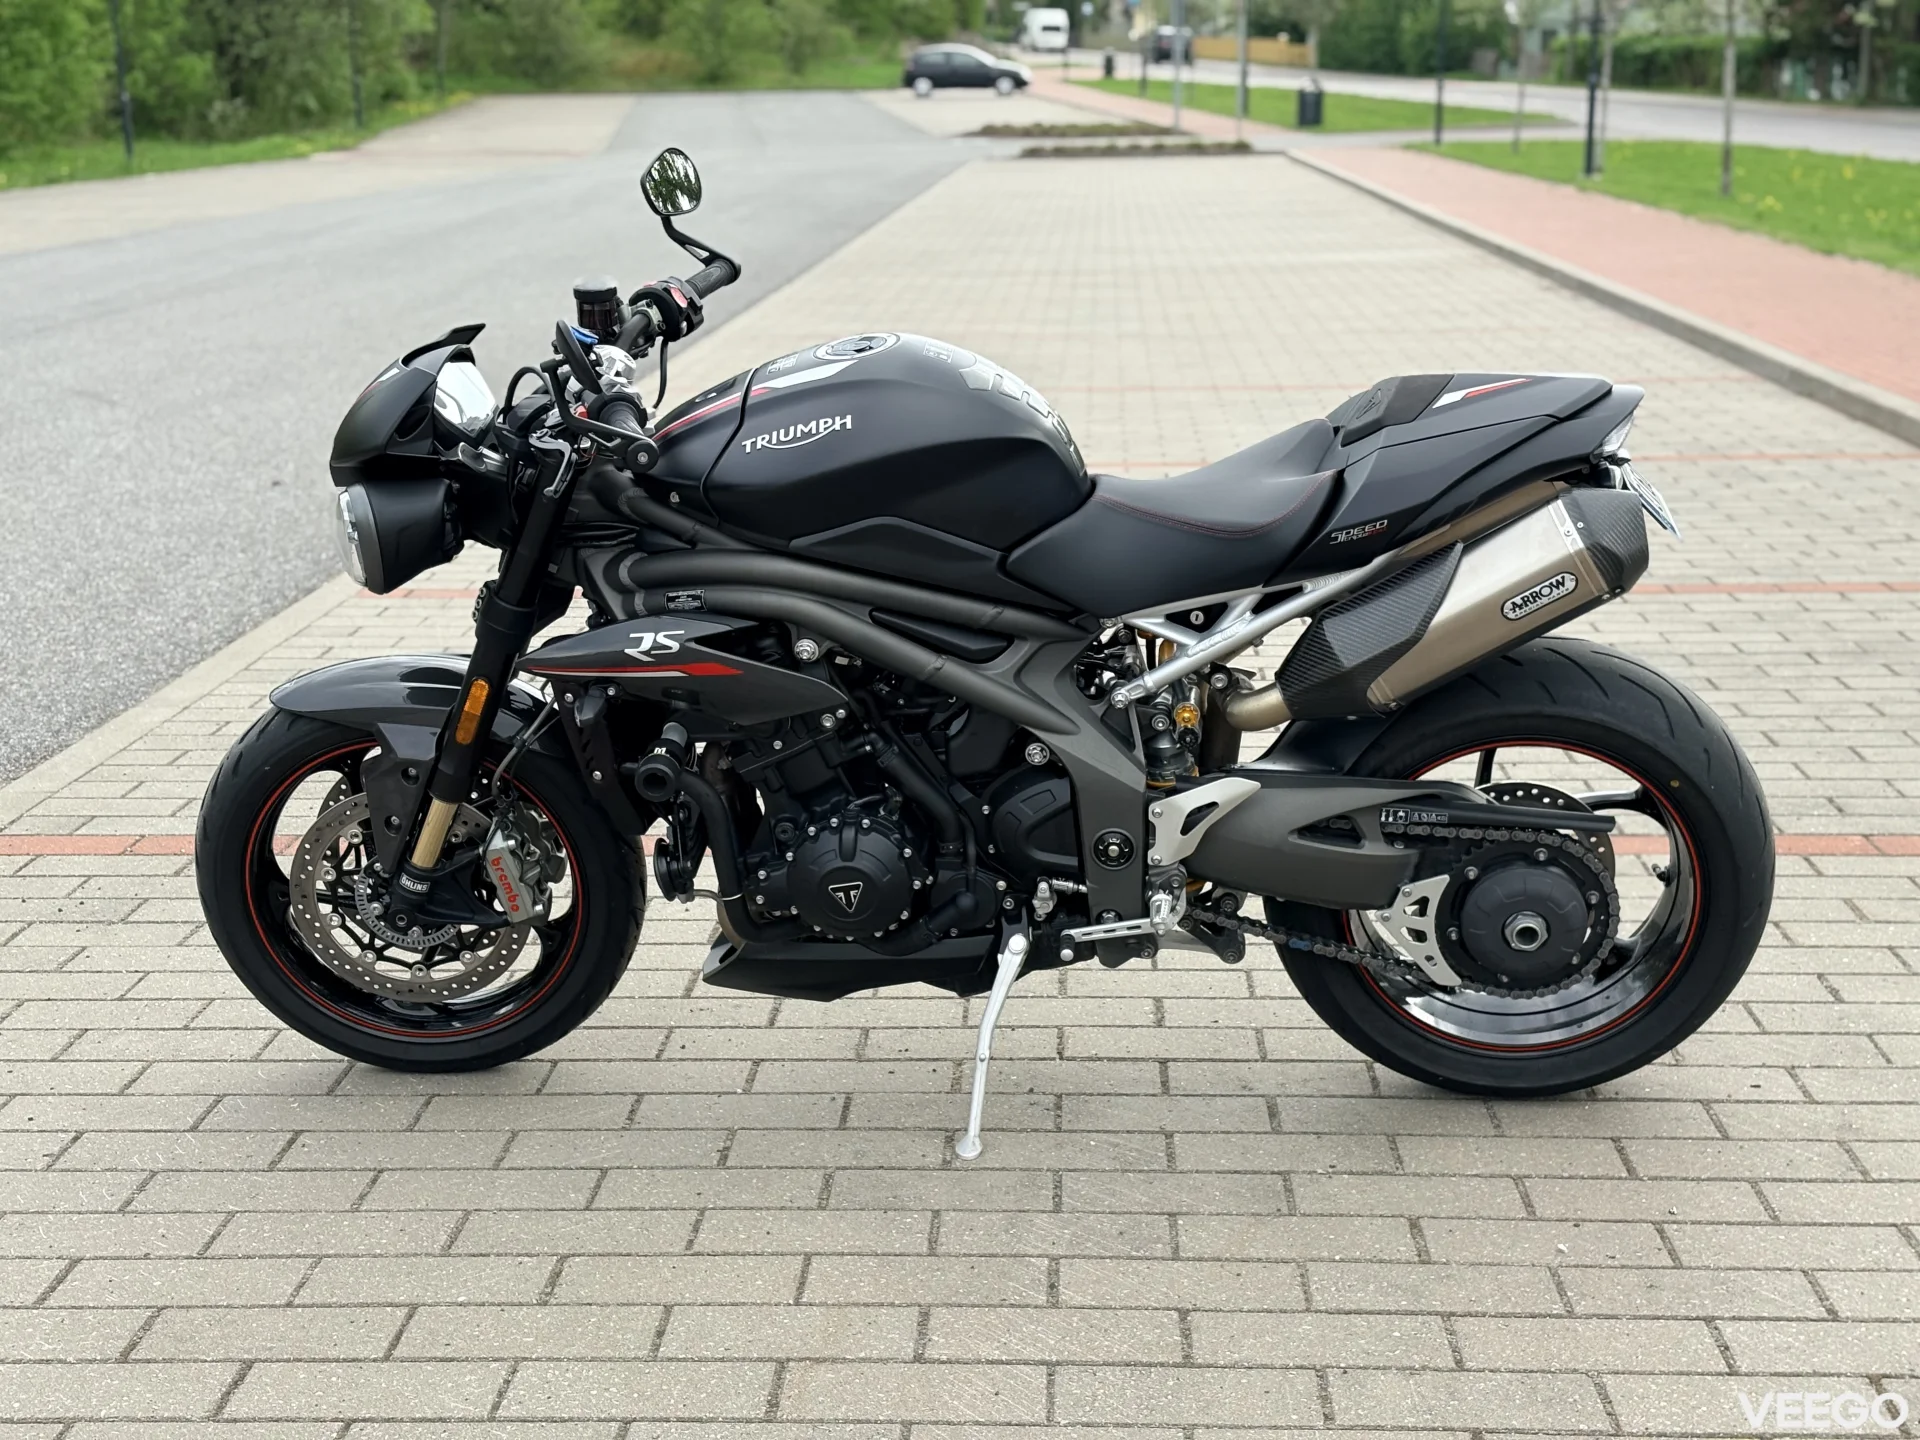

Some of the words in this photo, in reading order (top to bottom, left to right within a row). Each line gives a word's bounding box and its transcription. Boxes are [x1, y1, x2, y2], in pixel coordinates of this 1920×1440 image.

[741, 414, 852, 454] TRIUMPH
[1329, 519, 1388, 545] SPEED
[1509, 575, 1566, 615] ARROW
[624, 630, 685, 662] RS
[491, 856, 519, 913] brembo
